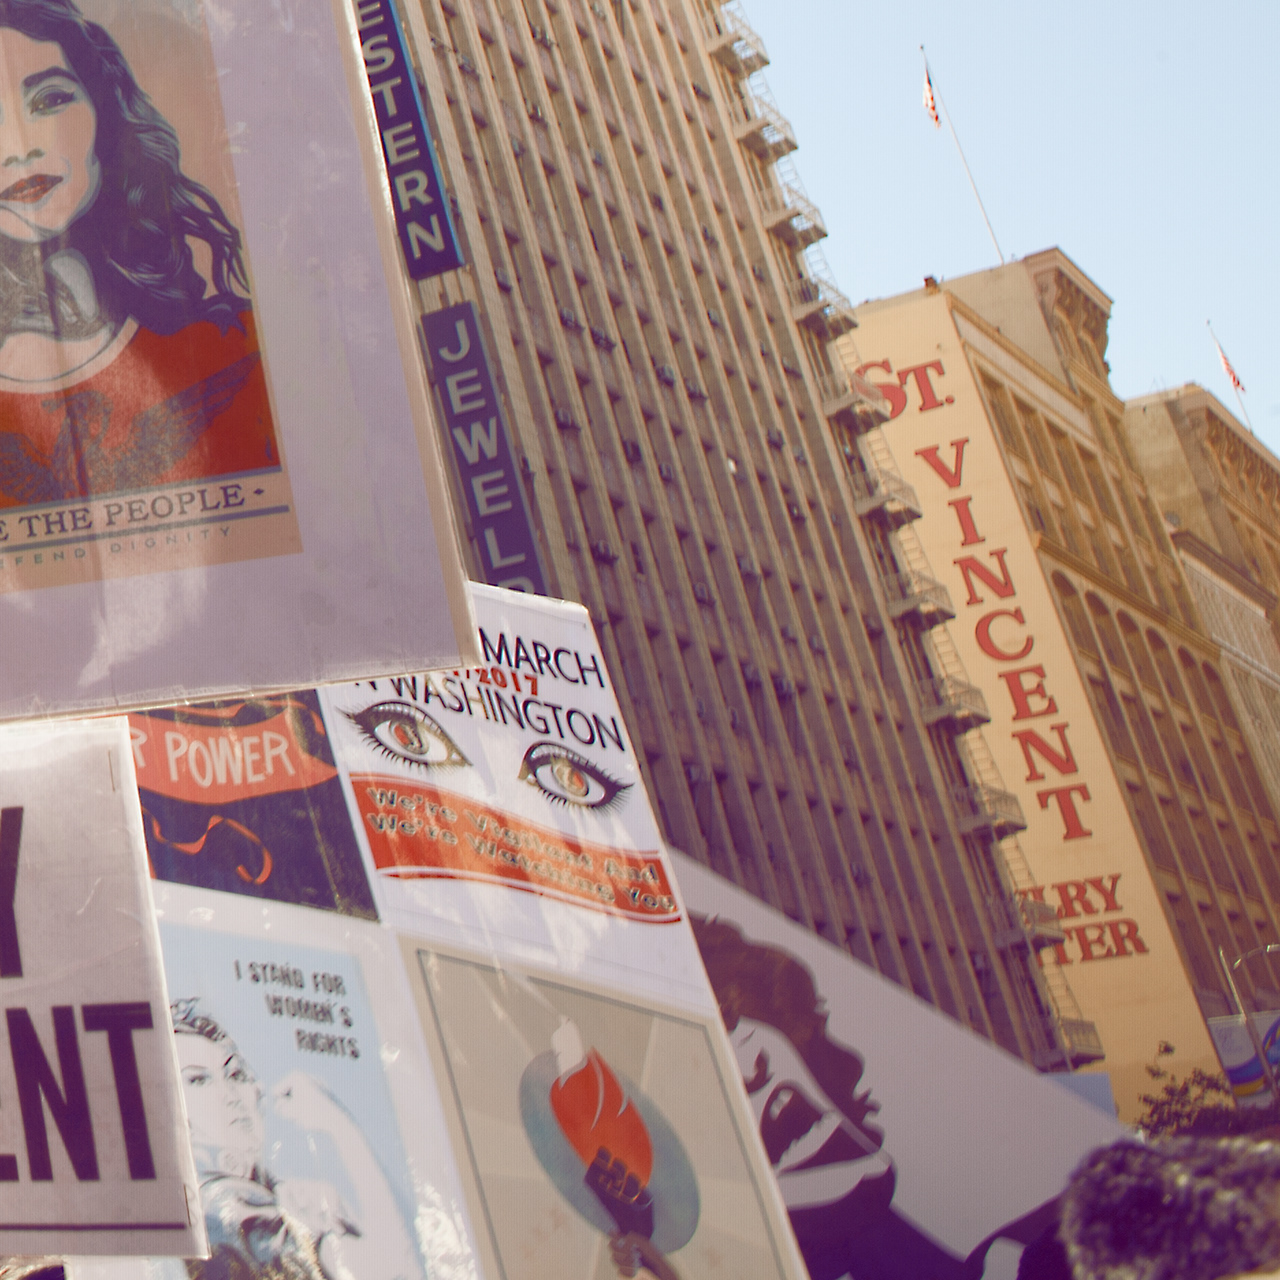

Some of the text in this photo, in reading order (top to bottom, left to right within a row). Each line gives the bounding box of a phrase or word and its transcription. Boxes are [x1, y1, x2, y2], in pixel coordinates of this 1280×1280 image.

[17, 507, 94, 540] THE
[103, 483, 245, 528] PEOPLE
[110, 524, 232, 555] DIGNITY
[478, 626, 605, 688] MARCH
[915, 437, 1092, 842] VINCENT
[390, 675, 626, 752] WASHINGTON
[165, 731, 296, 789] POWER
[366, 787, 659, 884] We're Vigilant And
[366, 813, 676, 912] We're Watching You
[234, 959, 347, 996] I STAND FOR
[296, 1028, 360, 1059] RIGHTS
